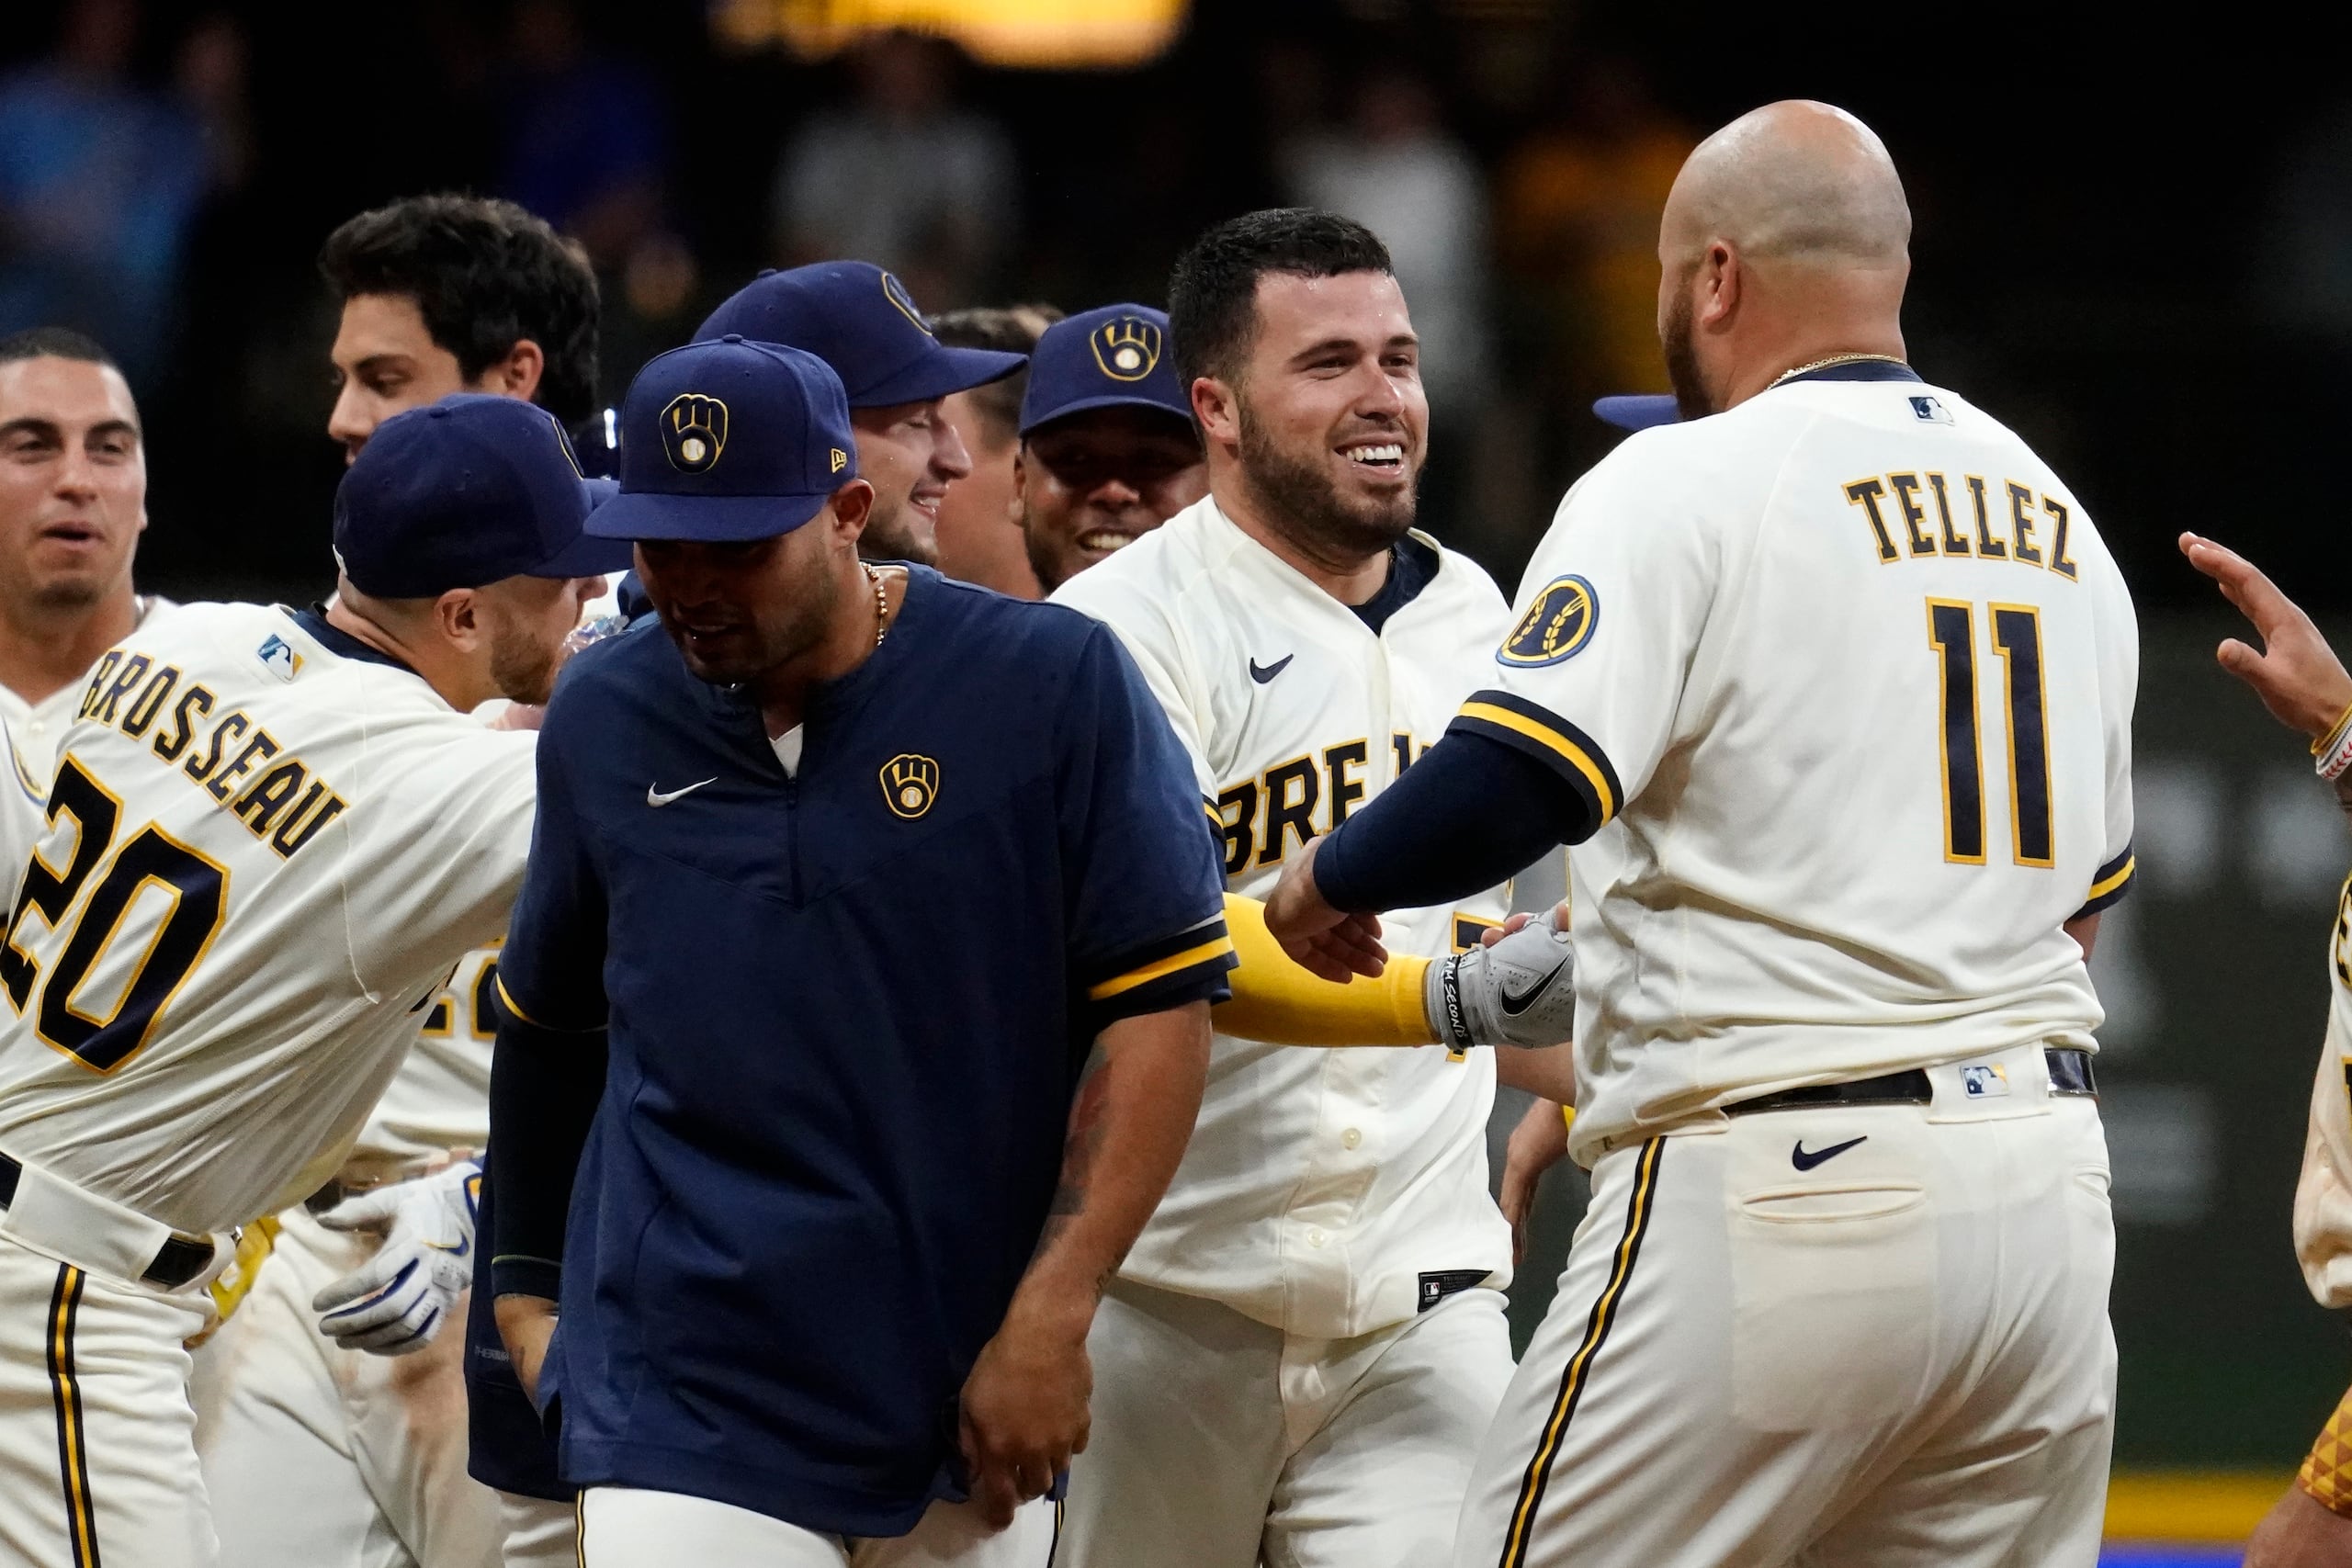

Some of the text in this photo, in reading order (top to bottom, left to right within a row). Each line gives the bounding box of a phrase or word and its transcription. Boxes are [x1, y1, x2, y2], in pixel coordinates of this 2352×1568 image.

[1842, 471, 2078, 582] TELLEZ
[77, 648, 350, 862] BROSSEAU
[1926, 596, 2055, 869] 11
[0, 750, 232, 1077] 20
[1445, 983, 1466, 1038] SECOND
